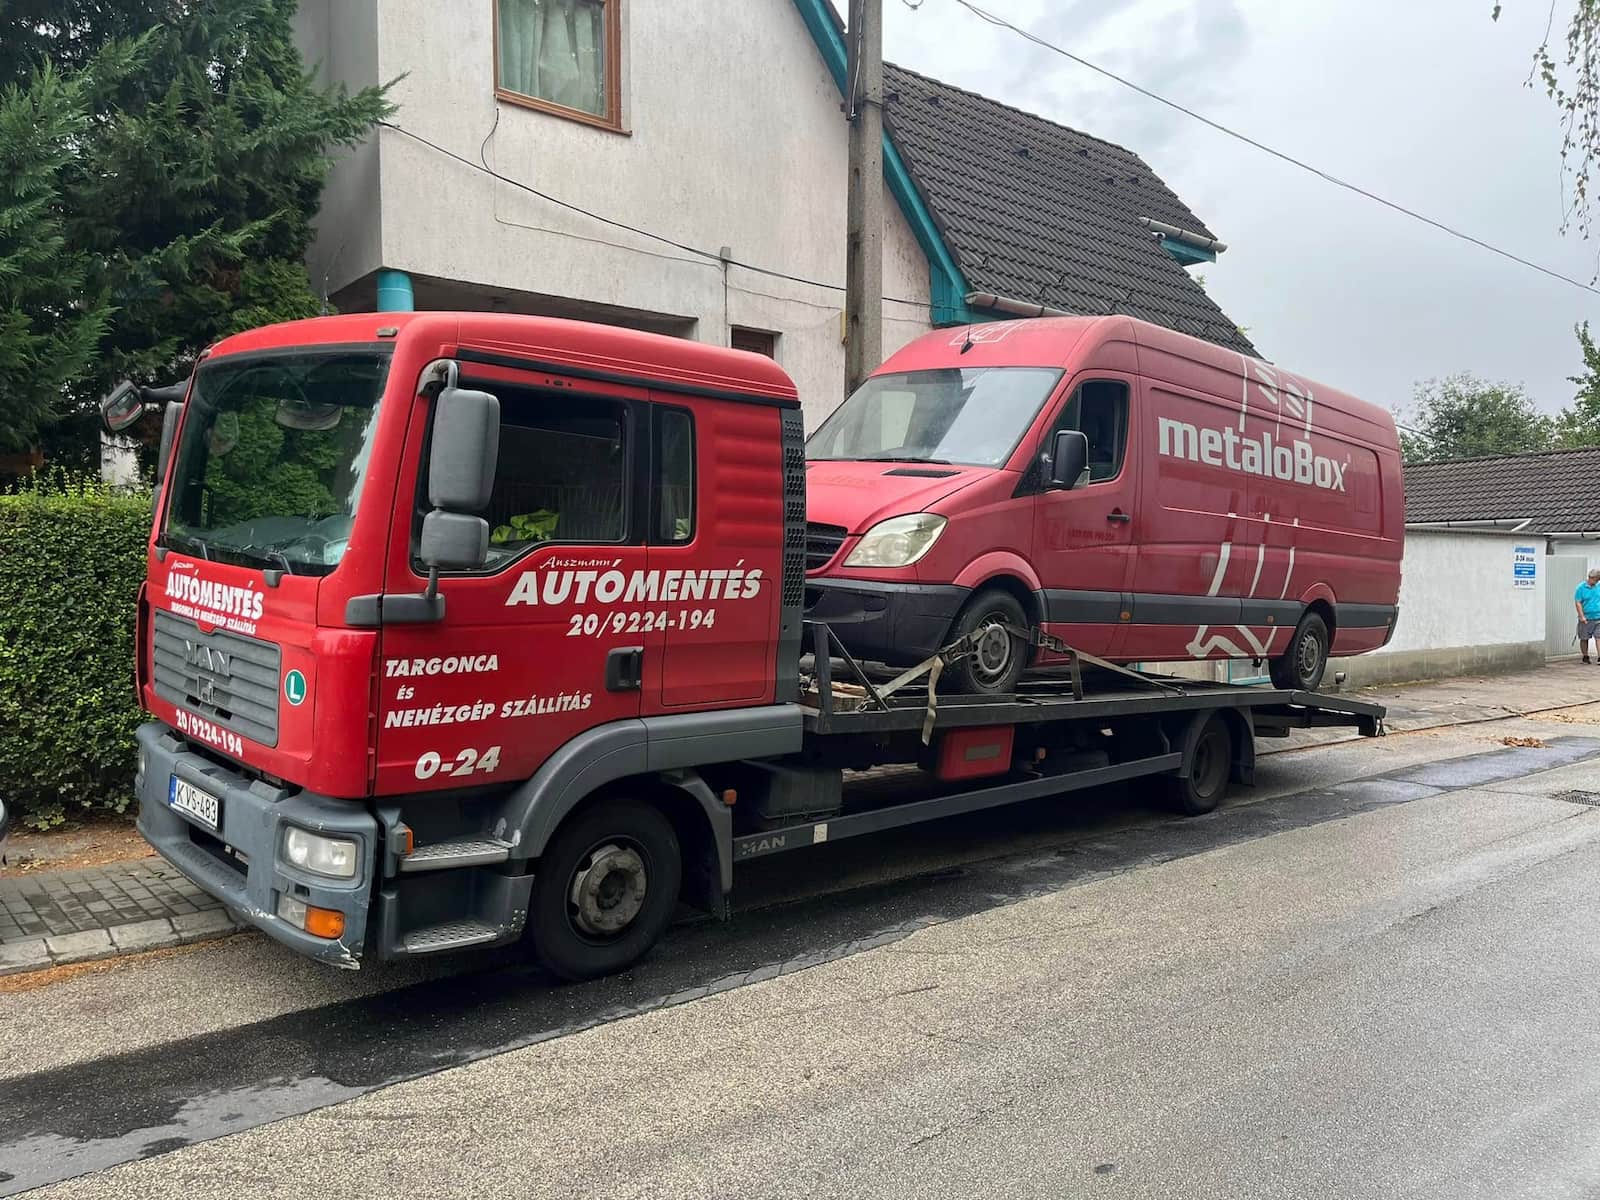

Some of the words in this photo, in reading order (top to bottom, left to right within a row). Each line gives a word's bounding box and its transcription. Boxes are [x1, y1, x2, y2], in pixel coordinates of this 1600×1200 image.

[1158, 416, 1347, 492] metaloBox
[165, 569, 264, 620] AUTÓMENTÉS
[505, 559, 763, 606] AUTÓMENTÉS
[566, 609, 716, 639] 20/9224-194
[385, 655, 499, 677] TARGONCA
[384, 700, 496, 729] NEHÉZGÉP
[500, 690, 593, 718] SZÁLLÍTÁS
[396, 685, 415, 700] ÉS
[175, 709, 243, 758] 20/9224-194
[414, 746, 502, 780] 0-24
[176, 782, 217, 822] KVS-483
